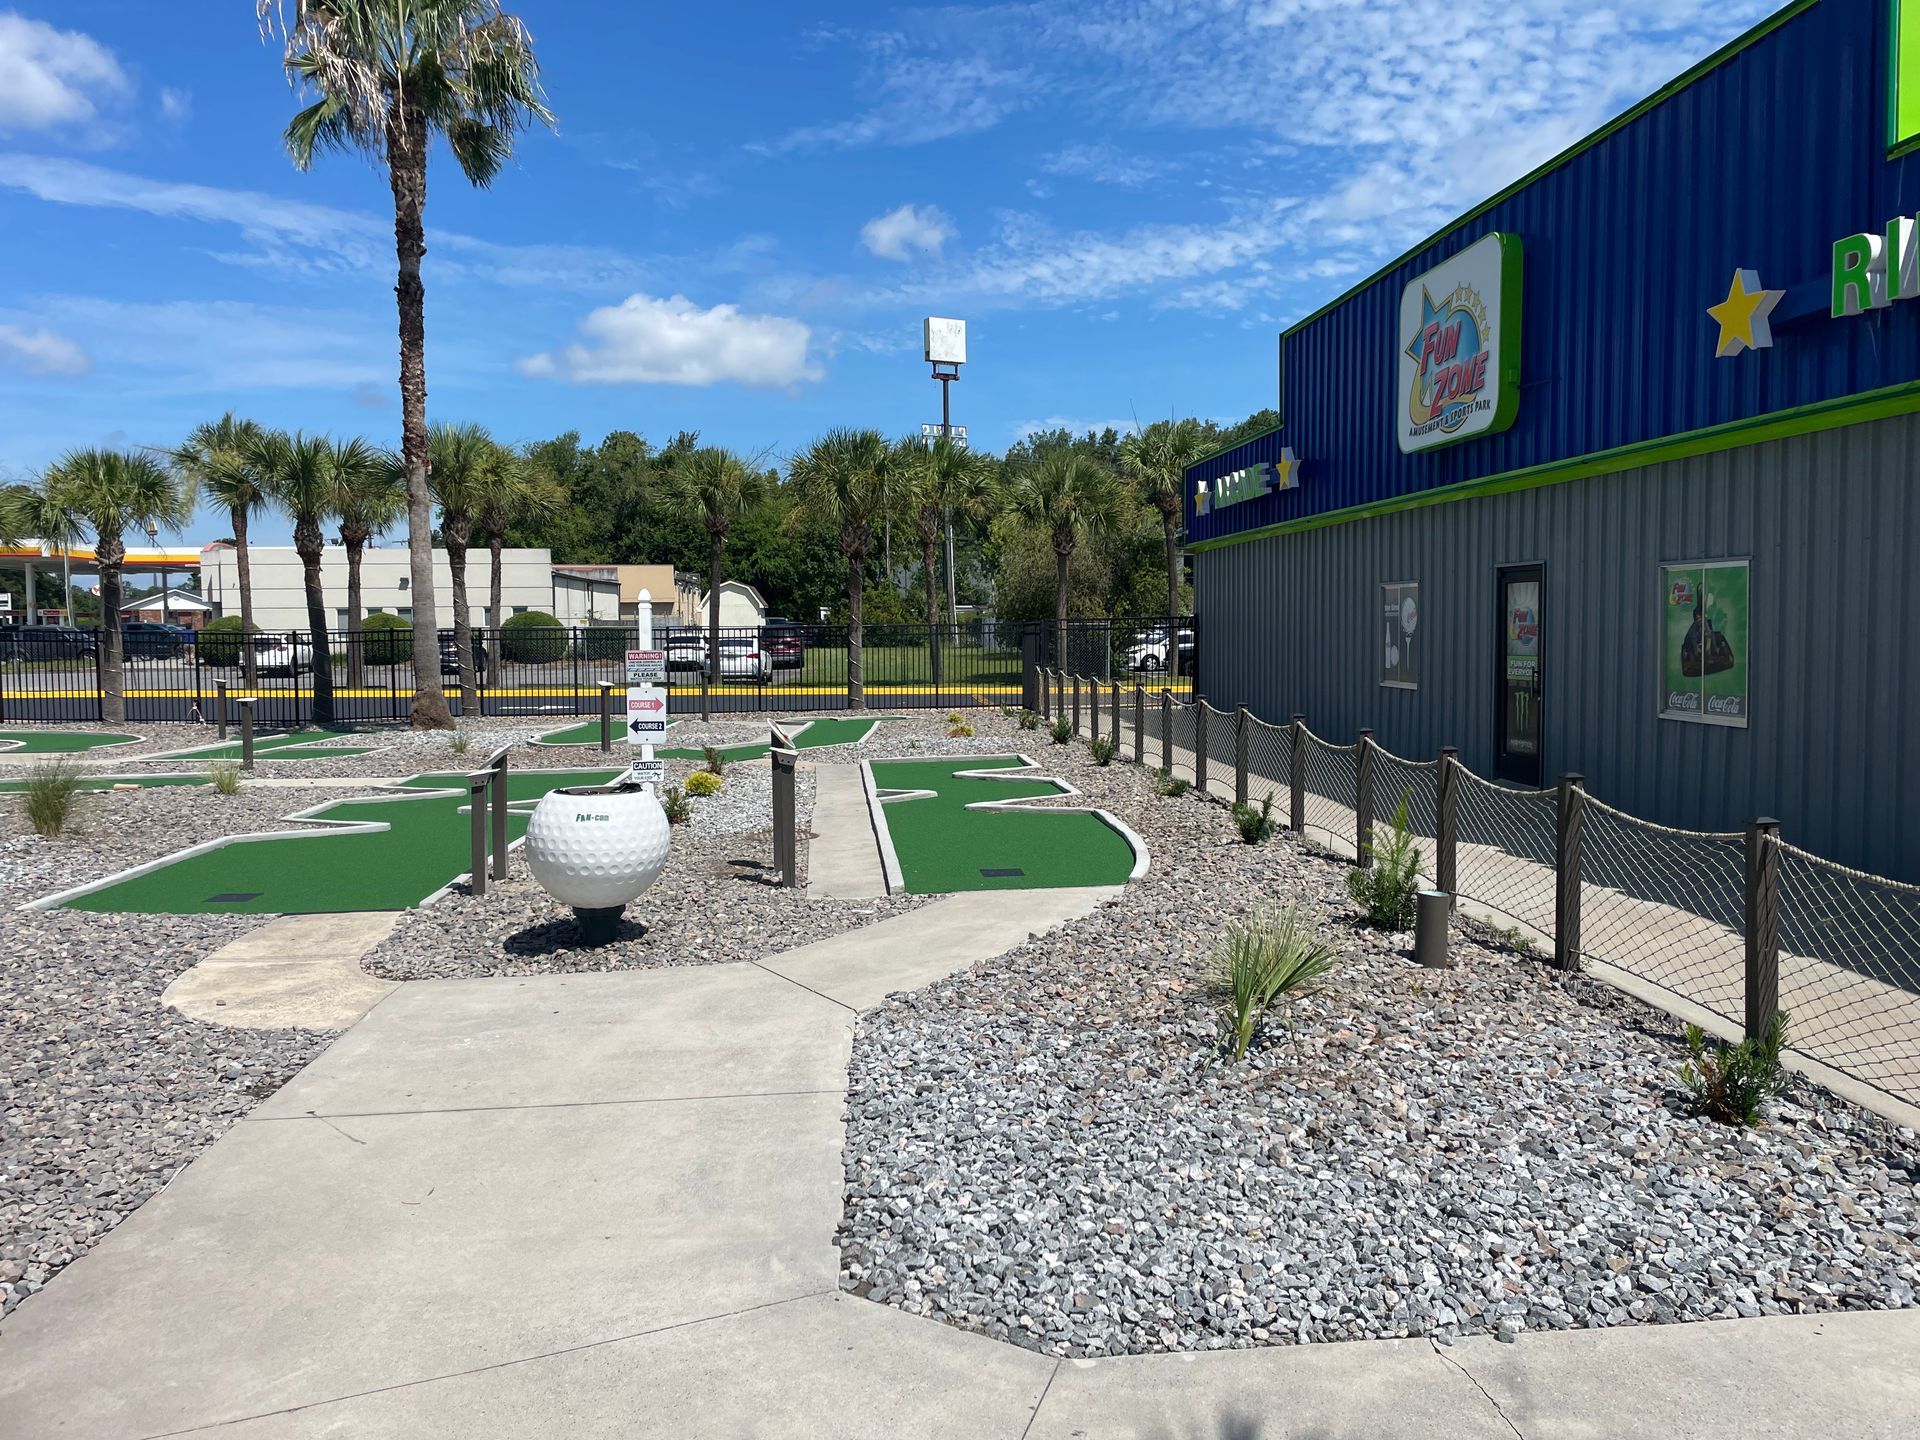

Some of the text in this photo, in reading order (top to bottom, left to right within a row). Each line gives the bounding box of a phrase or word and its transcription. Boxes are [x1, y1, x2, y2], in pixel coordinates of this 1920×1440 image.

[1831, 211, 1920, 318] RI
[1420, 320, 1462, 376] FUN
[1429, 350, 1489, 419] ZONE
[1409, 419, 1445, 437] AMUSEMENT
[1450, 403, 1474, 422] SPORTS
[1474, 400, 1491, 413] PARK
[1510, 660, 1536, 669] FUN FOR
[1507, 668, 1538, 677] EVERYOE
[630, 701, 651, 709] COURSE
[638, 722, 658, 730] COURSE
[633, 762, 662, 770] CAUTION
